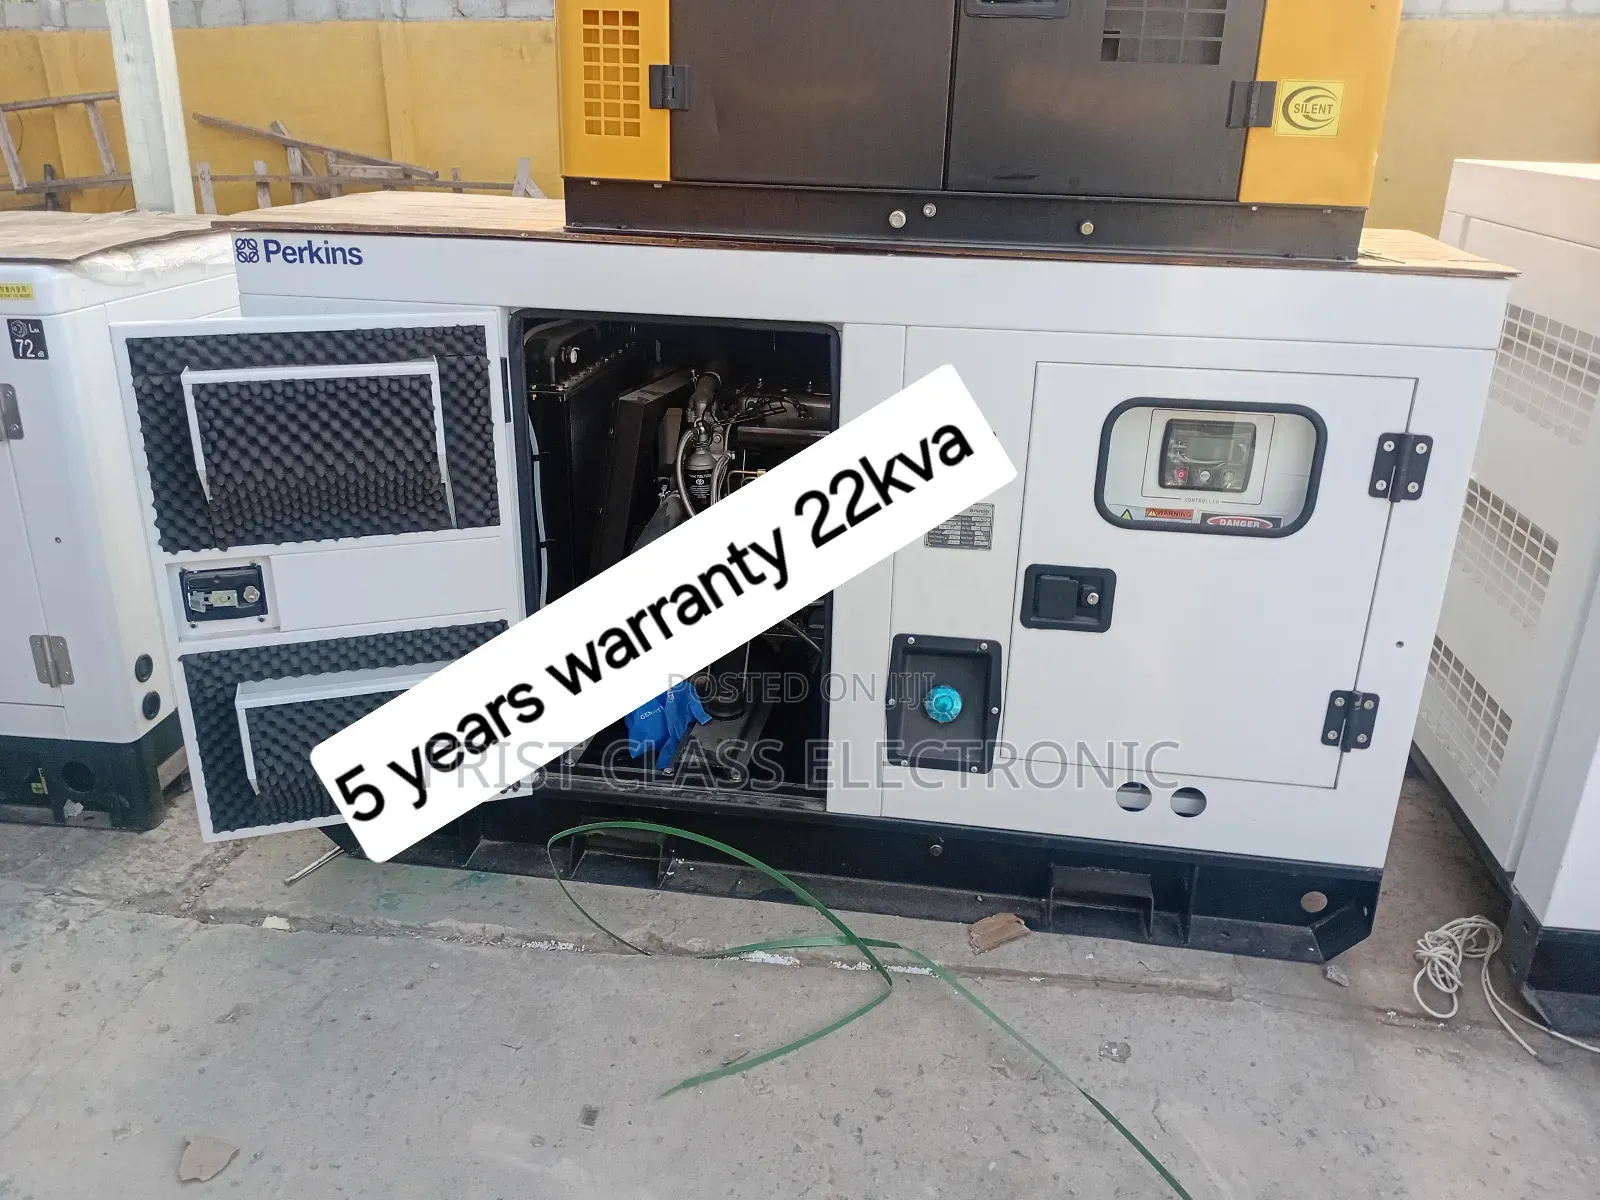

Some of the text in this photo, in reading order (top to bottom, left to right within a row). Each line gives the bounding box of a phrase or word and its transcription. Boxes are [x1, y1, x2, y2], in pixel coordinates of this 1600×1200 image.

[1293, 102, 1334, 115] SILENT
[263, 239, 363, 265] Perkins
[15, 338, 35, 357] 72
[1157, 509, 1192, 518] WARNING
[1219, 518, 1260, 528] DANGER
